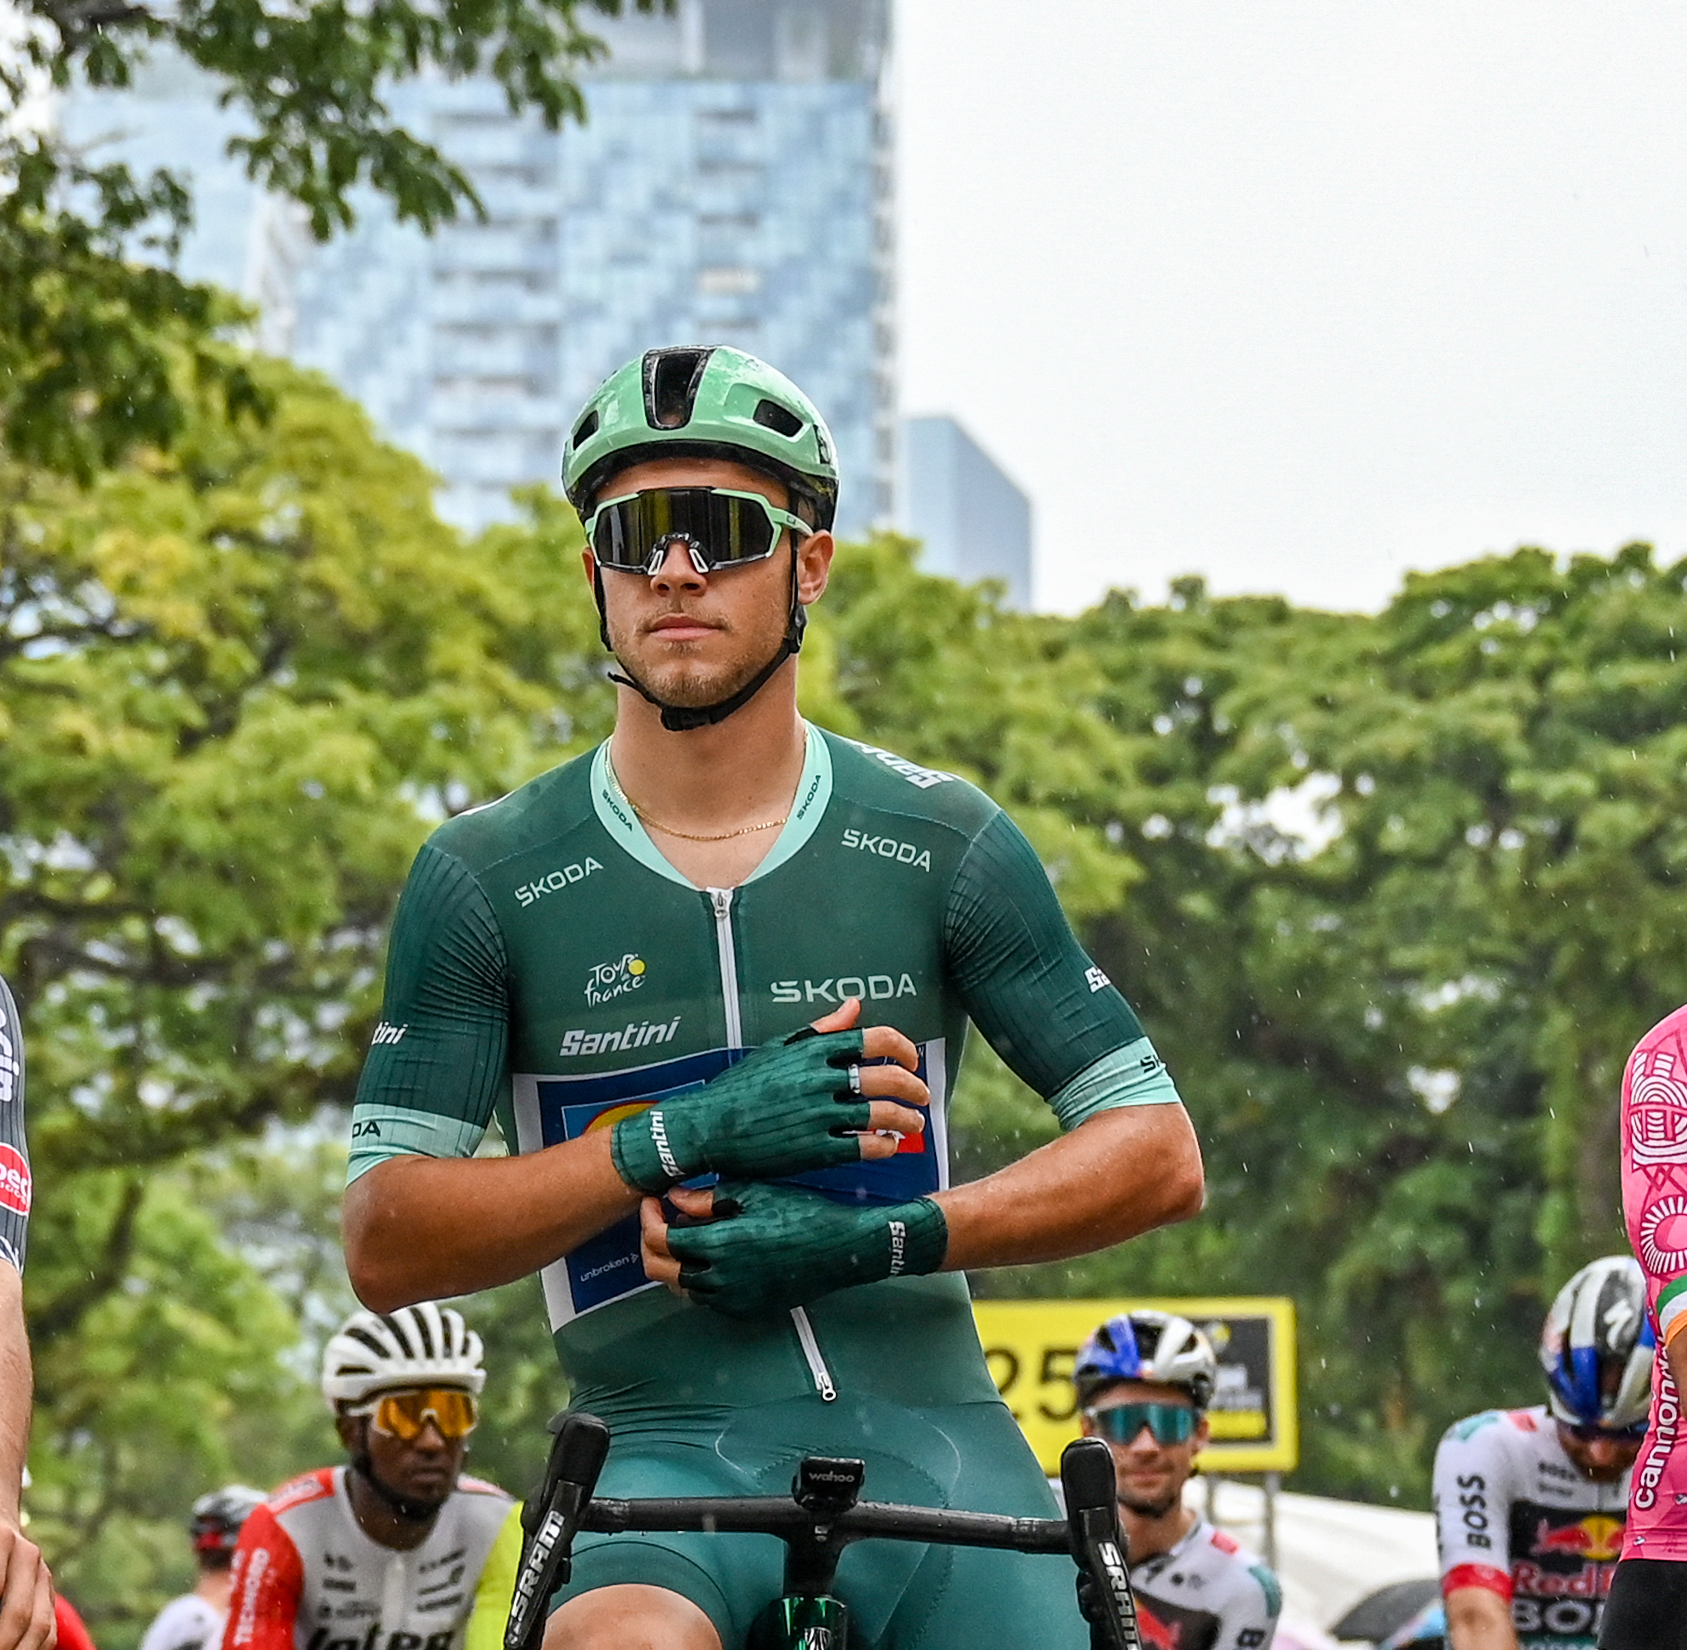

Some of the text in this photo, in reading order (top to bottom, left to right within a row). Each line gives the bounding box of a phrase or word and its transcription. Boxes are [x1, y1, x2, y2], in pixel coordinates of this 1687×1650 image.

[559, 1015, 681, 1057] Santini
[580, 1255, 630, 1282] unbroken
[808, 1469, 855, 1484] wahoo
[1457, 1475, 1492, 1550] BOSS
[511, 1510, 566, 1622] SRAM
